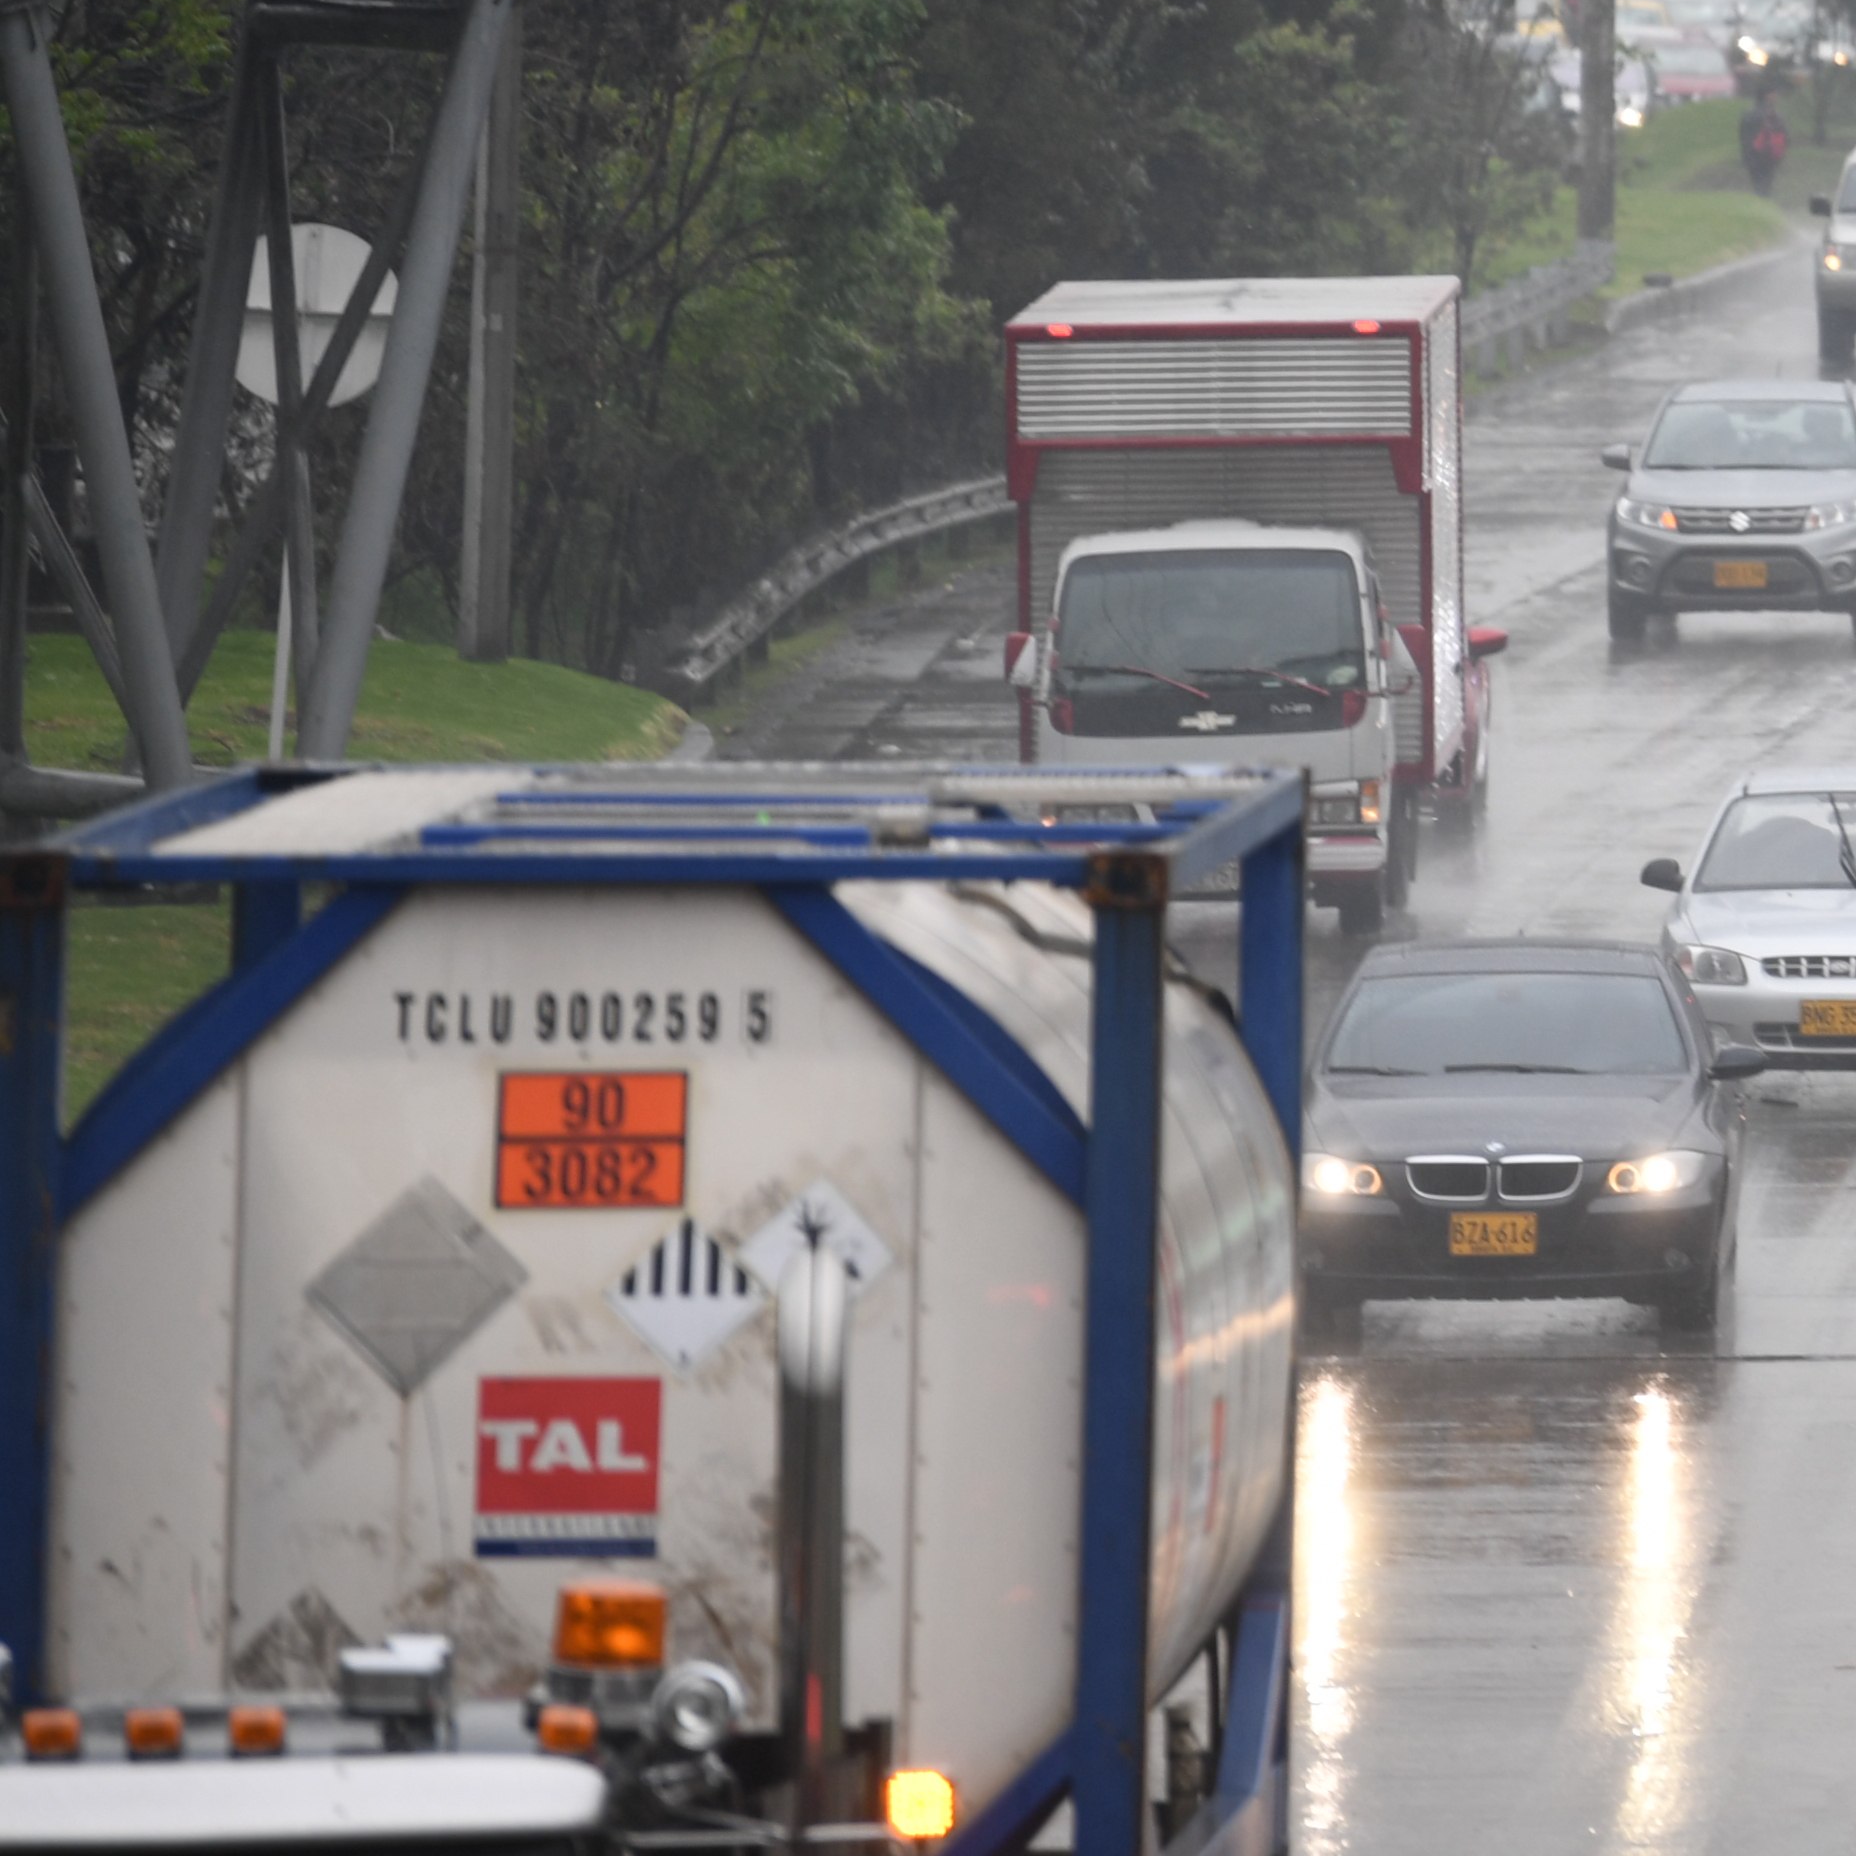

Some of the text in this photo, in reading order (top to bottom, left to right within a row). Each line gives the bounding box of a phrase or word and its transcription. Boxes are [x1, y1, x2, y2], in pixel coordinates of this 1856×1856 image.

[395, 991, 771, 1042] TCLU 900259 5
[562, 1079, 626, 1131] 90
[522, 1147, 658, 1201] 3082
[478, 1418, 649, 1473] TAL
